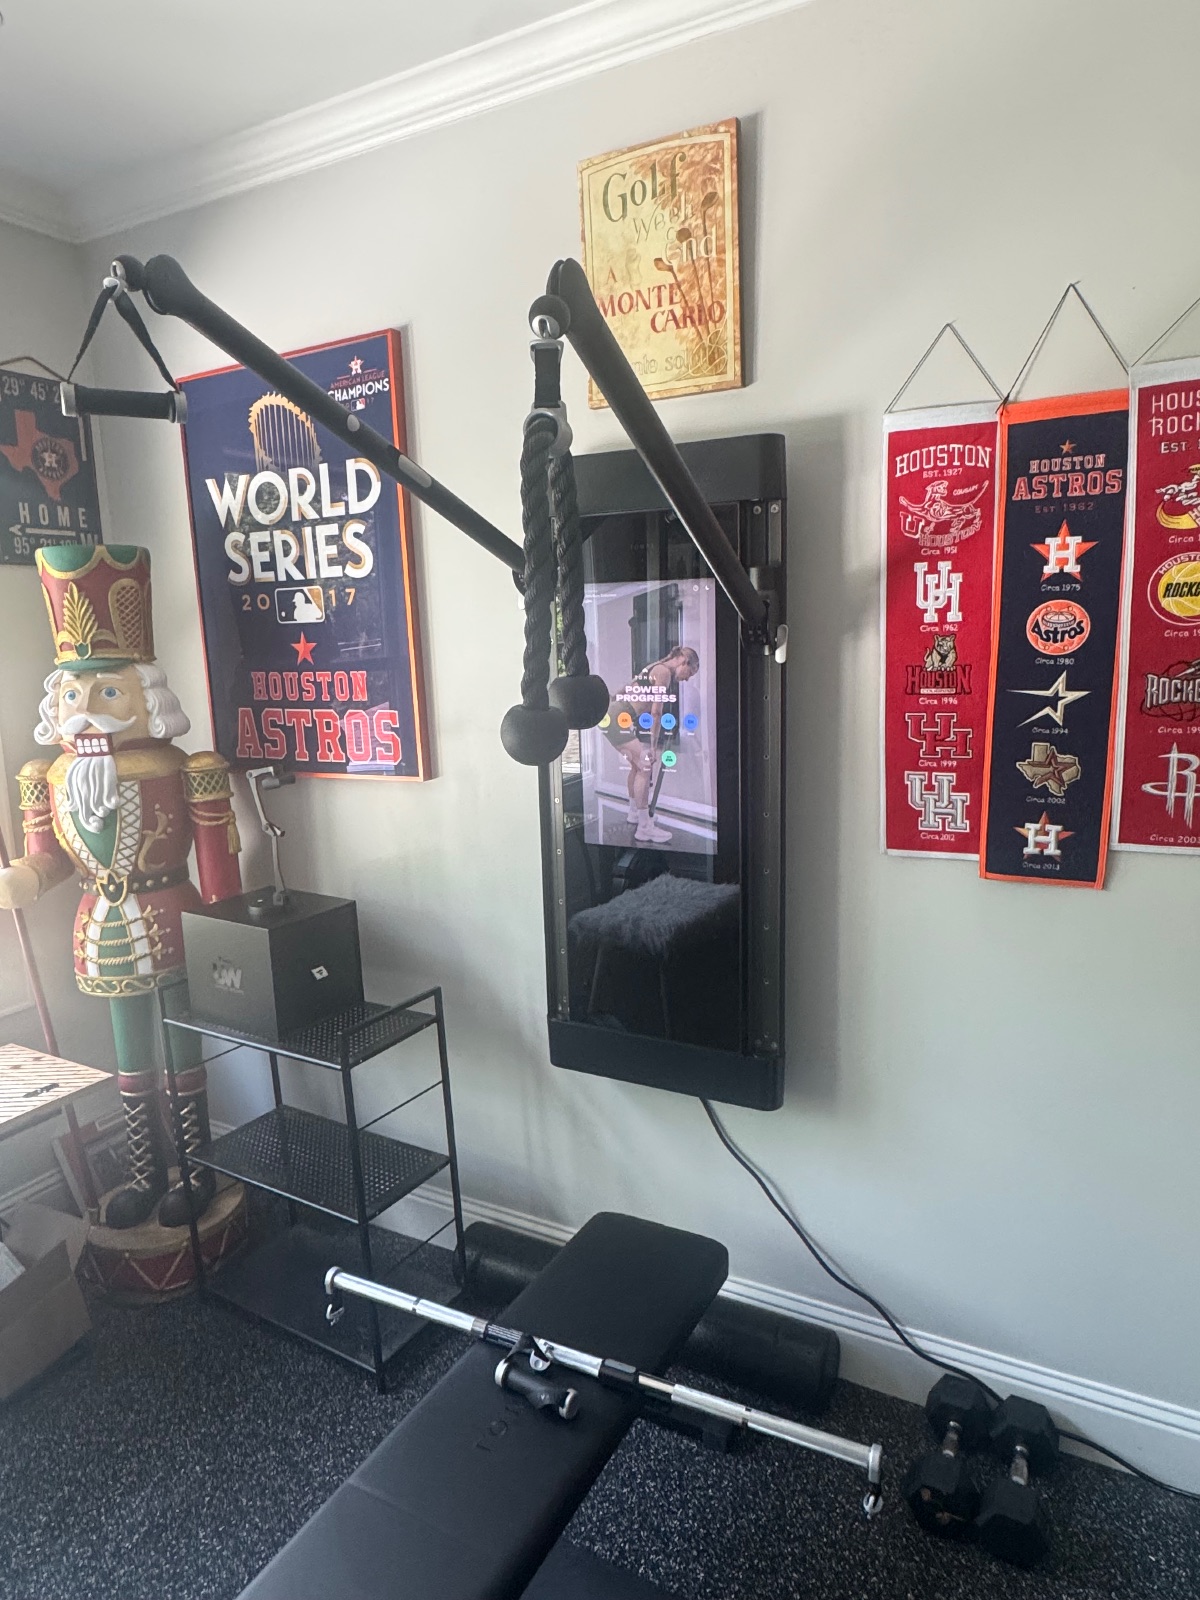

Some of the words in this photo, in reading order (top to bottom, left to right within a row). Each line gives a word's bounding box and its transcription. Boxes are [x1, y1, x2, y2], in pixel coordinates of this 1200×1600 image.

[602, 151, 687, 222] Golf
[606, 267, 618, 285] A
[597, 281, 683, 318] MONTE
[650, 300, 725, 334] CARLO
[330, 376, 360, 389] AMERICAN
[361, 370, 385, 383] LEAGUE
[895, 443, 992, 478] HOUSTON
[1029, 454, 1106, 474] HOUSTON
[943, 468, 963, 476] 1927
[205, 457, 382, 528] WORLD
[1012, 469, 1123, 501] ASTROS
[19, 502, 88, 529] HOME
[1063, 502, 1095, 512] 1962
[1168, 535, 1194, 543] Circa
[224, 519, 374, 586] SERIES
[944, 546, 958, 554] 1951
[1043, 536, 1082, 573] H
[914, 561, 963, 623] UH
[1062, 583, 1080, 591] 1975
[242, 593, 270, 611] 20
[328, 588, 356, 607] 17
[942, 624, 959, 632] 1962
[1031, 617, 1085, 644] Astros
[1164, 629, 1189, 637] Circa
[251, 671, 368, 701] HOUSTON
[625, 685, 667, 694] POWER
[616, 694, 677, 703] PROGRESS
[918, 697, 938, 705] Circa
[941, 697, 958, 705] 1996
[236, 708, 402, 765] ASTROS
[905, 713, 972, 758] UH
[1158, 726, 1183, 734] Circa
[905, 771, 970, 832] UH
[920, 832, 939, 840] Circa
[1023, 822, 1063, 856] H
[1150, 834, 1174, 842] Circa
[1022, 861, 1041, 869] Circa
